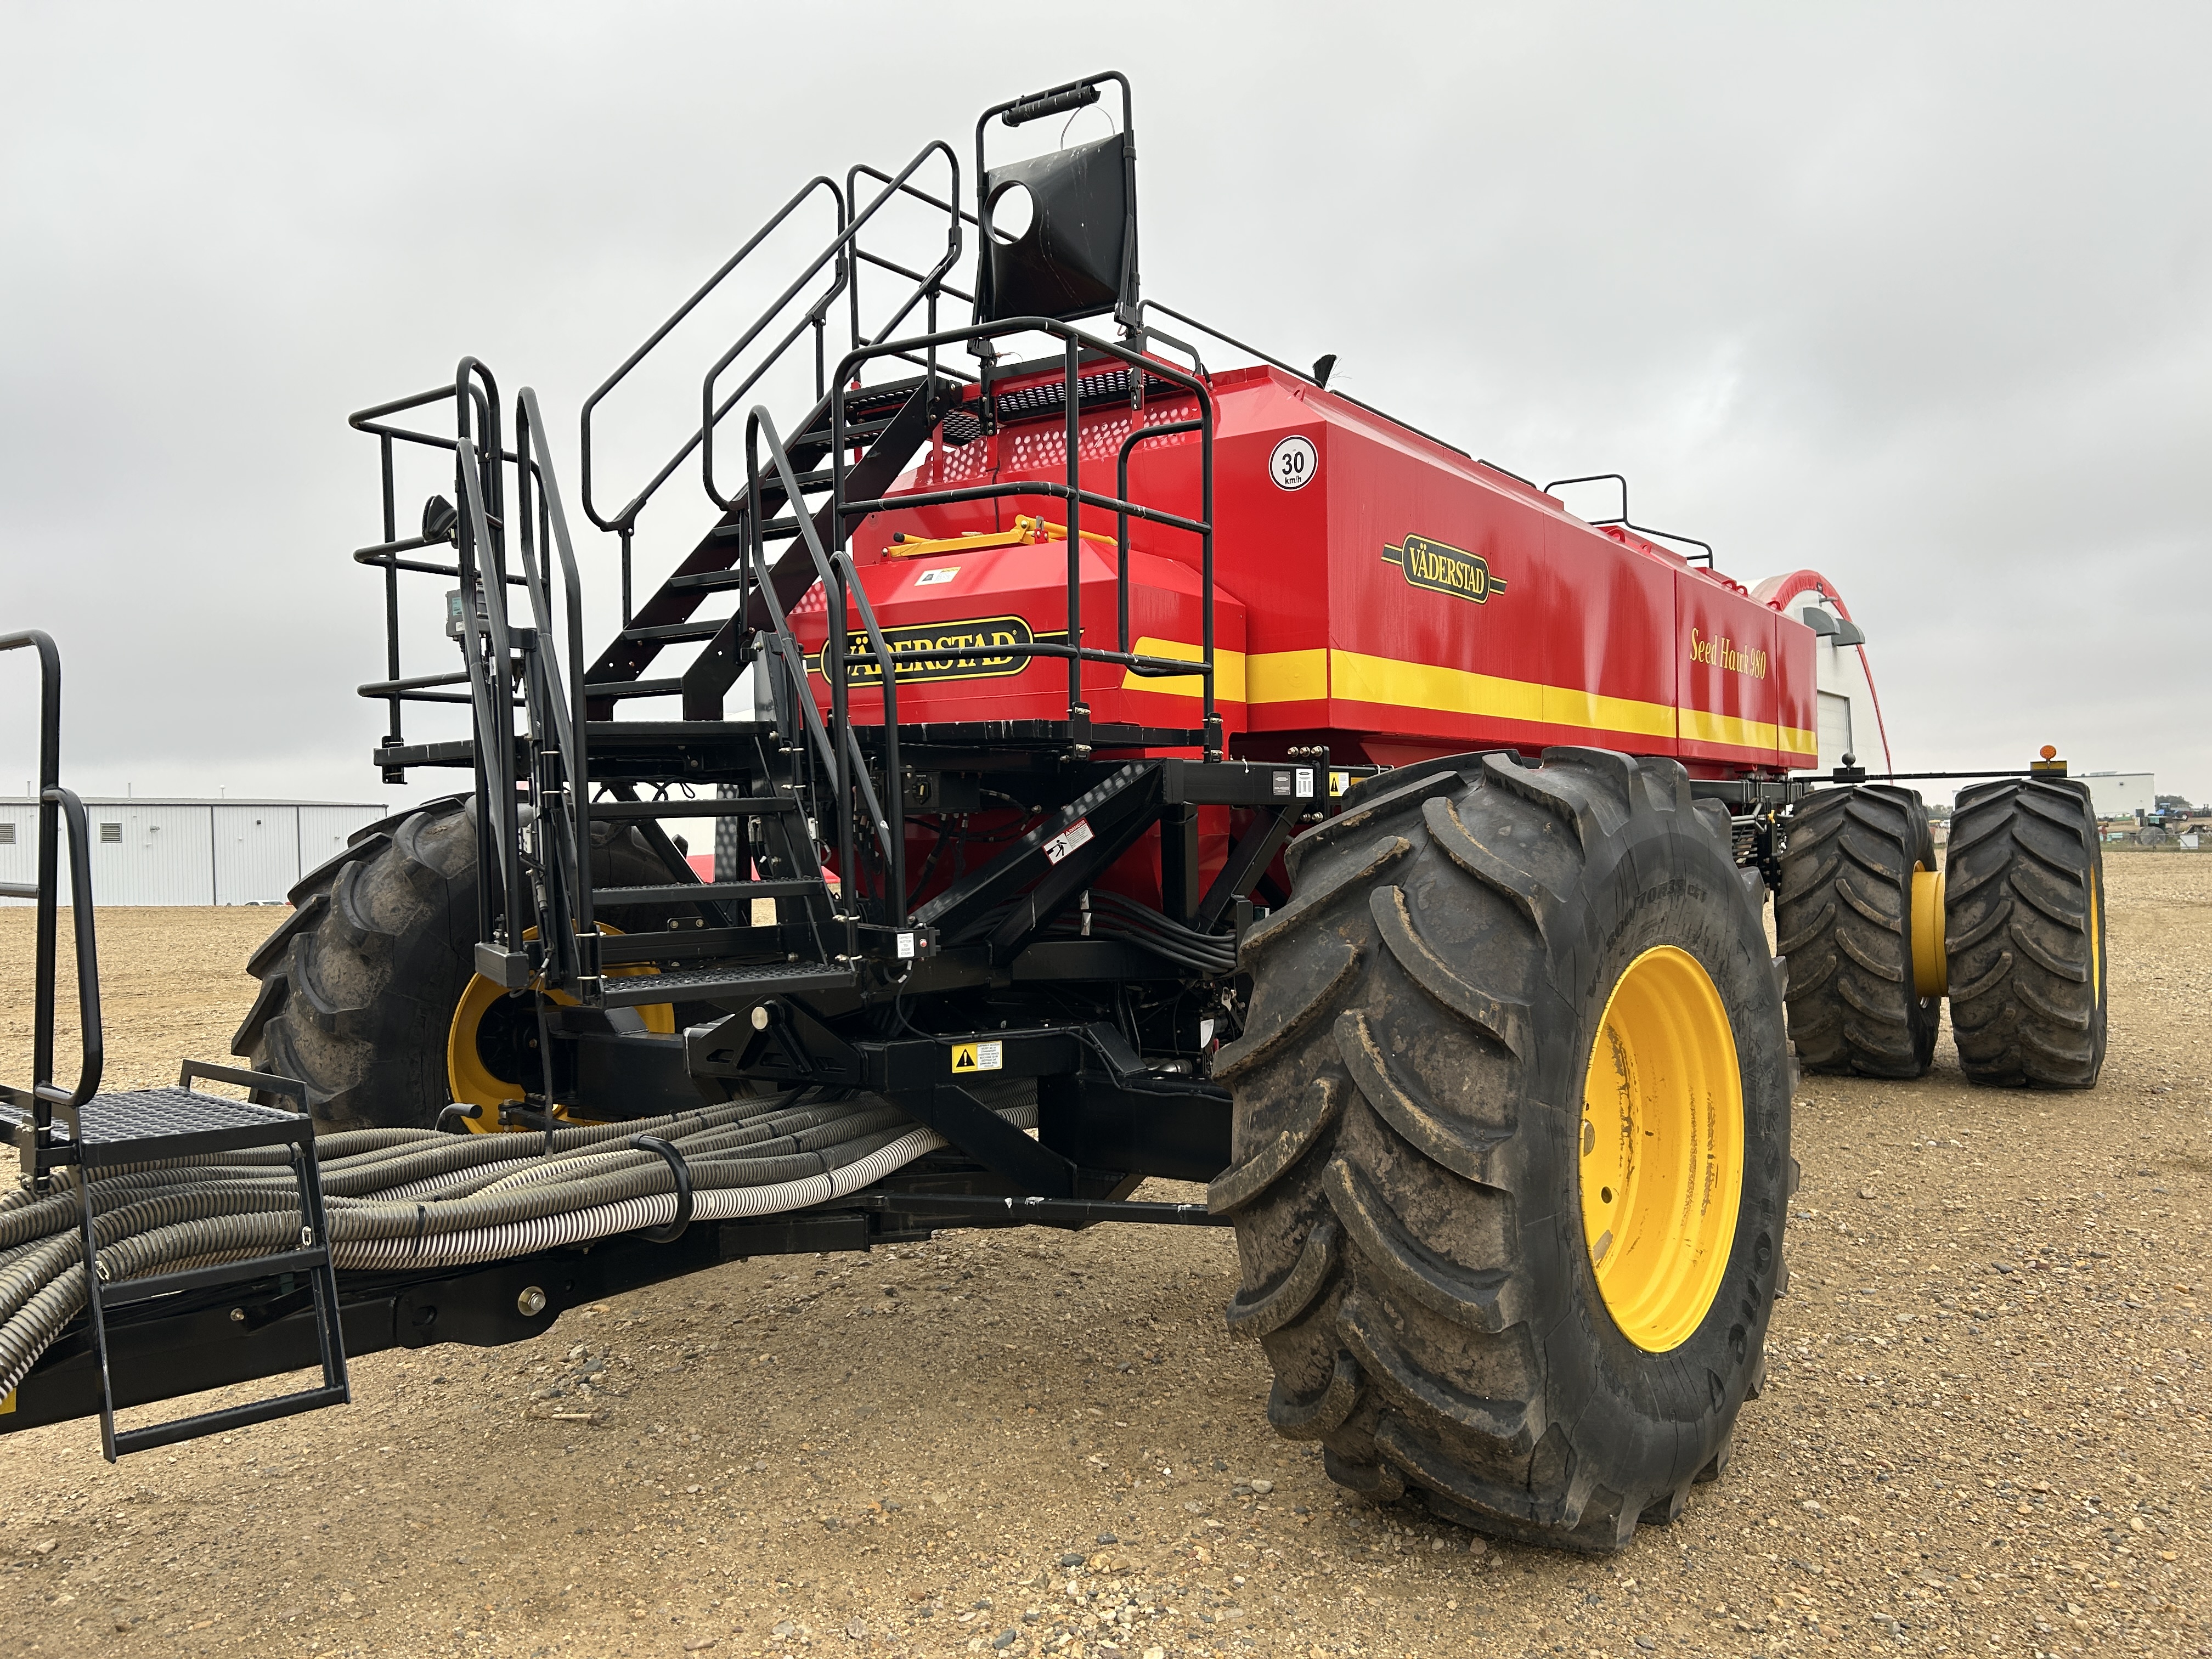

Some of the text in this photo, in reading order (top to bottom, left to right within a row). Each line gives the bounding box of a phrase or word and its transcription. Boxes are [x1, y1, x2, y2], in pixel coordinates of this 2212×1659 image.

[1282, 452, 1304, 475] 30
[1285, 475, 1302, 484] km/h
[1409, 543, 1485, 594] VÄDERSTAD
[847, 631, 1016, 676] ÄERSTAD
[1690, 627, 1766, 680] Seed Hawk 980
[1069, 820, 1086, 833] DANGER
